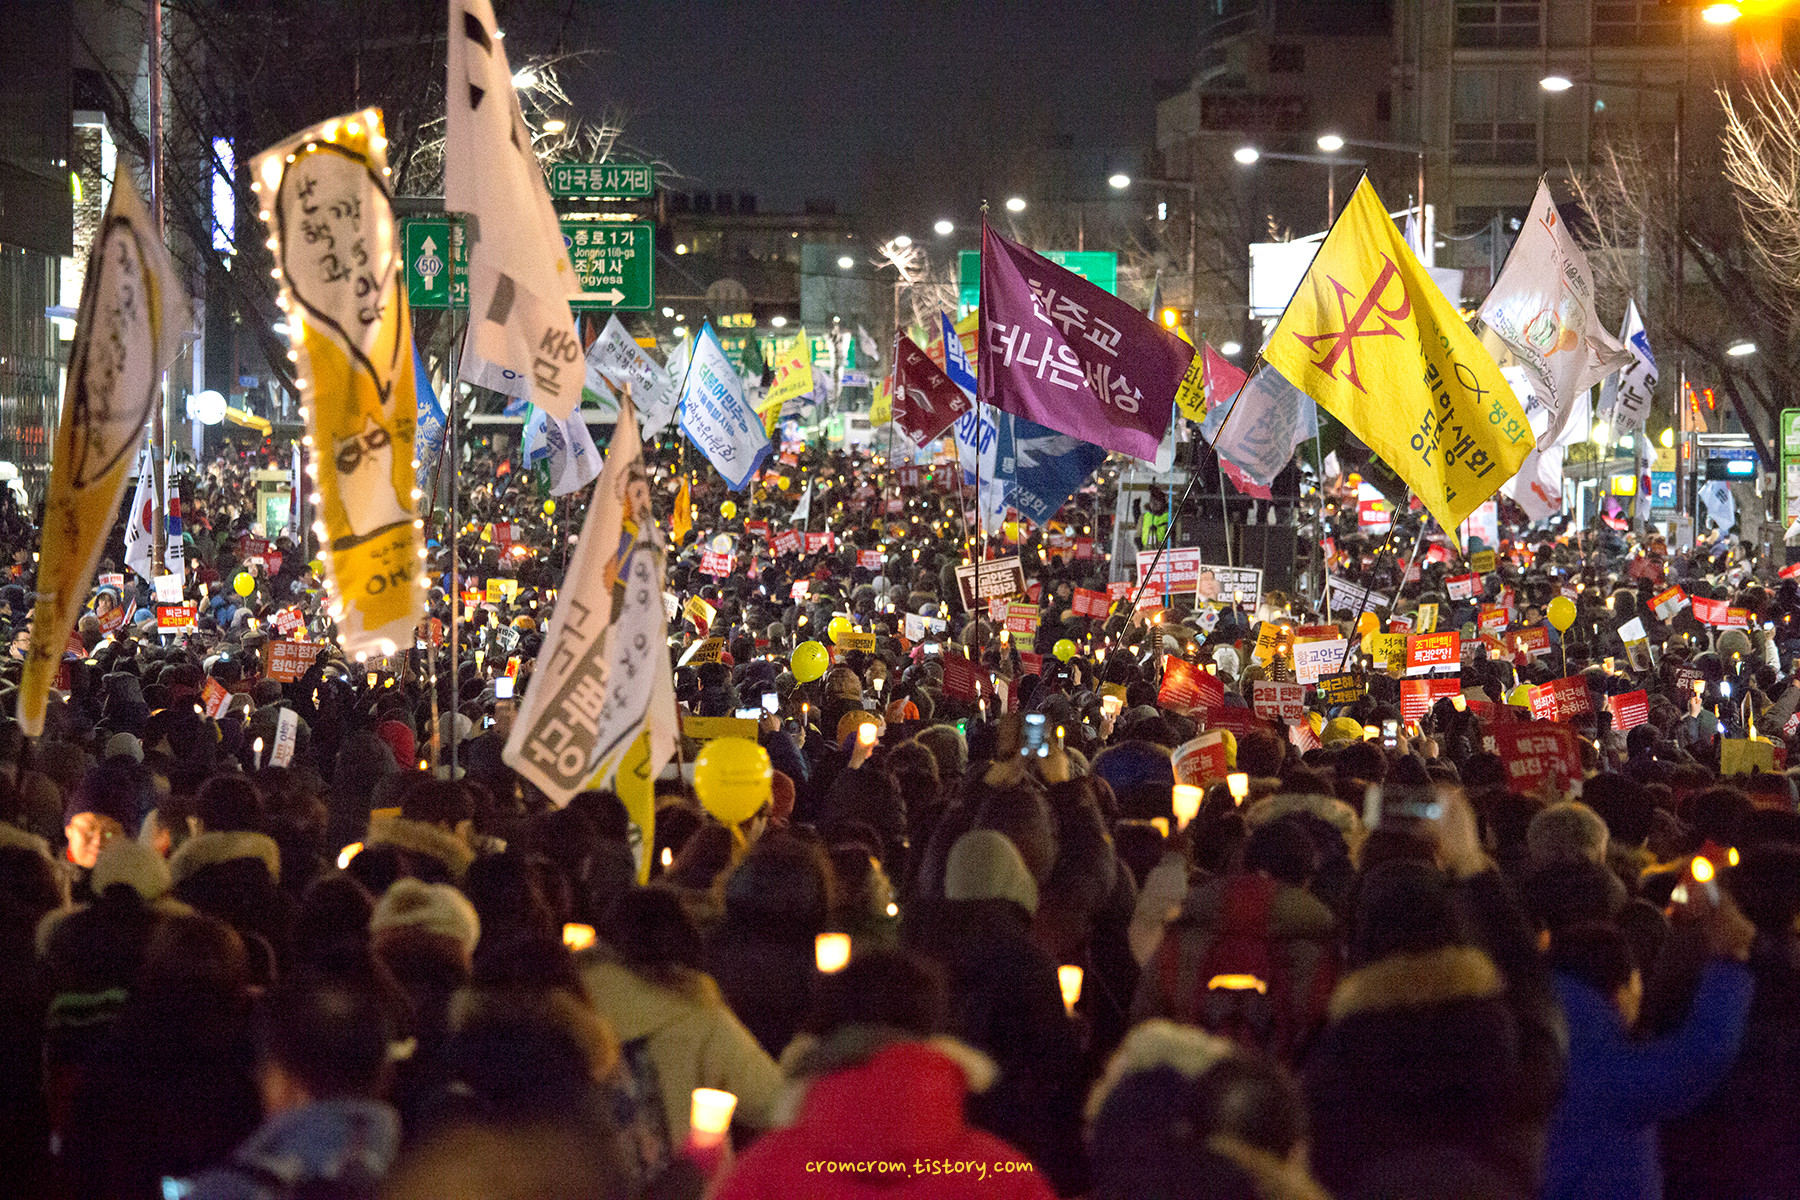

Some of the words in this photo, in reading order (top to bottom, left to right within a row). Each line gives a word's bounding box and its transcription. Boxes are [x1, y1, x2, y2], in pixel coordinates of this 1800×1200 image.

[557, 170, 650, 191] 안국동사거리
[574, 230, 635, 245] 종로1가
[574, 247, 605, 259] Jongno
[420, 258, 438, 273] 50
[574, 259, 624, 274] 조계사
[1028, 279, 1123, 358] 천주교
[988, 319, 1144, 414] 더나은세상
[1488, 400, 1526, 446] 평화
[165, 608, 191, 617] 박근혜
[1414, 636, 1453, 650] 조기탄핵!
[1296, 647, 1345, 667] 황교안도
[1414, 648, 1452, 661] 특검연장!
[1320, 676, 1354, 691] 박근혜
[1254, 688, 1277, 702] 2월
[1280, 688, 1304, 702] 탄핵
[1533, 694, 1555, 711] 범죄자
[1555, 685, 1587, 703] 박근혜
[1551, 698, 1591, 721] 구속하라
